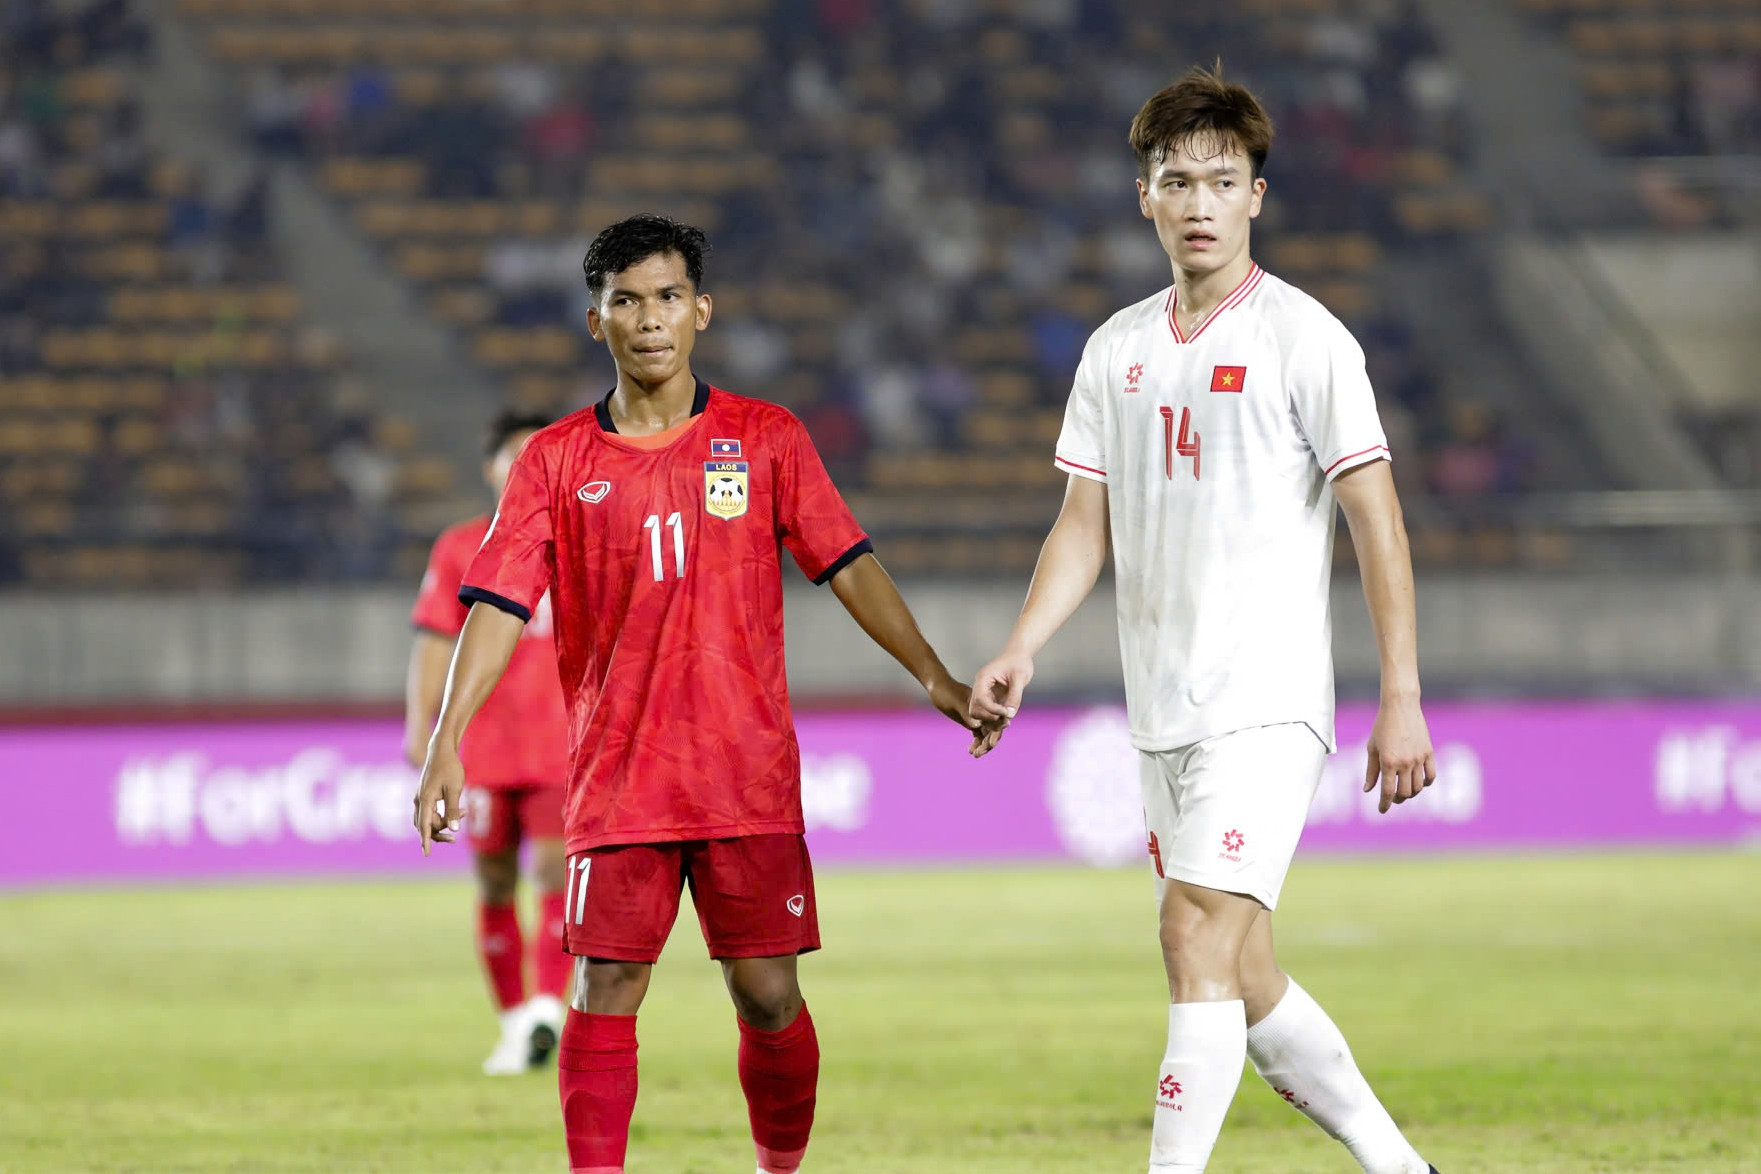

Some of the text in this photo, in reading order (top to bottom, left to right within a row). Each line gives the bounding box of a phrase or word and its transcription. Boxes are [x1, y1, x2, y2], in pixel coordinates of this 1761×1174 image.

[715, 463, 738, 471] LAOS
[1159, 406, 1201, 481] 14
[643, 511, 685, 582] 11
[565, 855, 592, 925] 11
